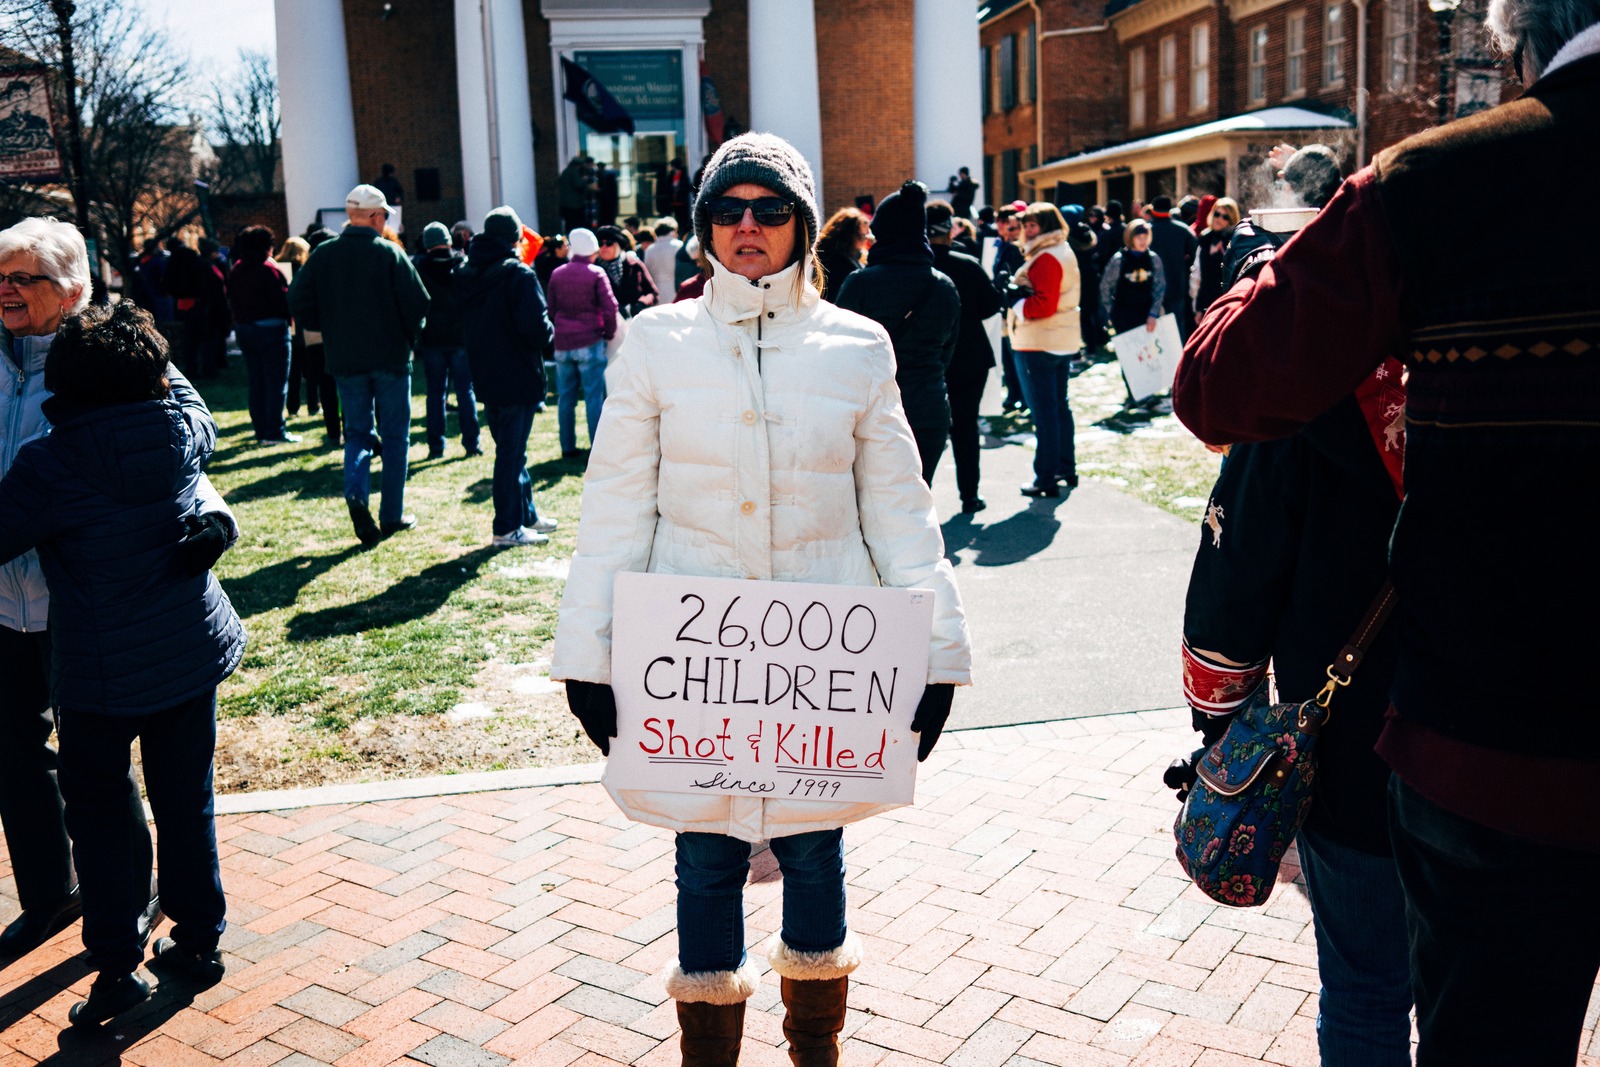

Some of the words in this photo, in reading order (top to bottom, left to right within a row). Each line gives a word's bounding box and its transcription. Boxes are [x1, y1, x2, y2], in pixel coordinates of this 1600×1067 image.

[676, 594, 876, 654] 26,000
[644, 656, 898, 714] CHILDREN
[639, 718, 734, 761] Shot
[747, 720, 763, 763] &
[775, 723, 887, 771] Killed
[690, 771, 775, 793] Since
[789, 778, 842, 797] 1999
